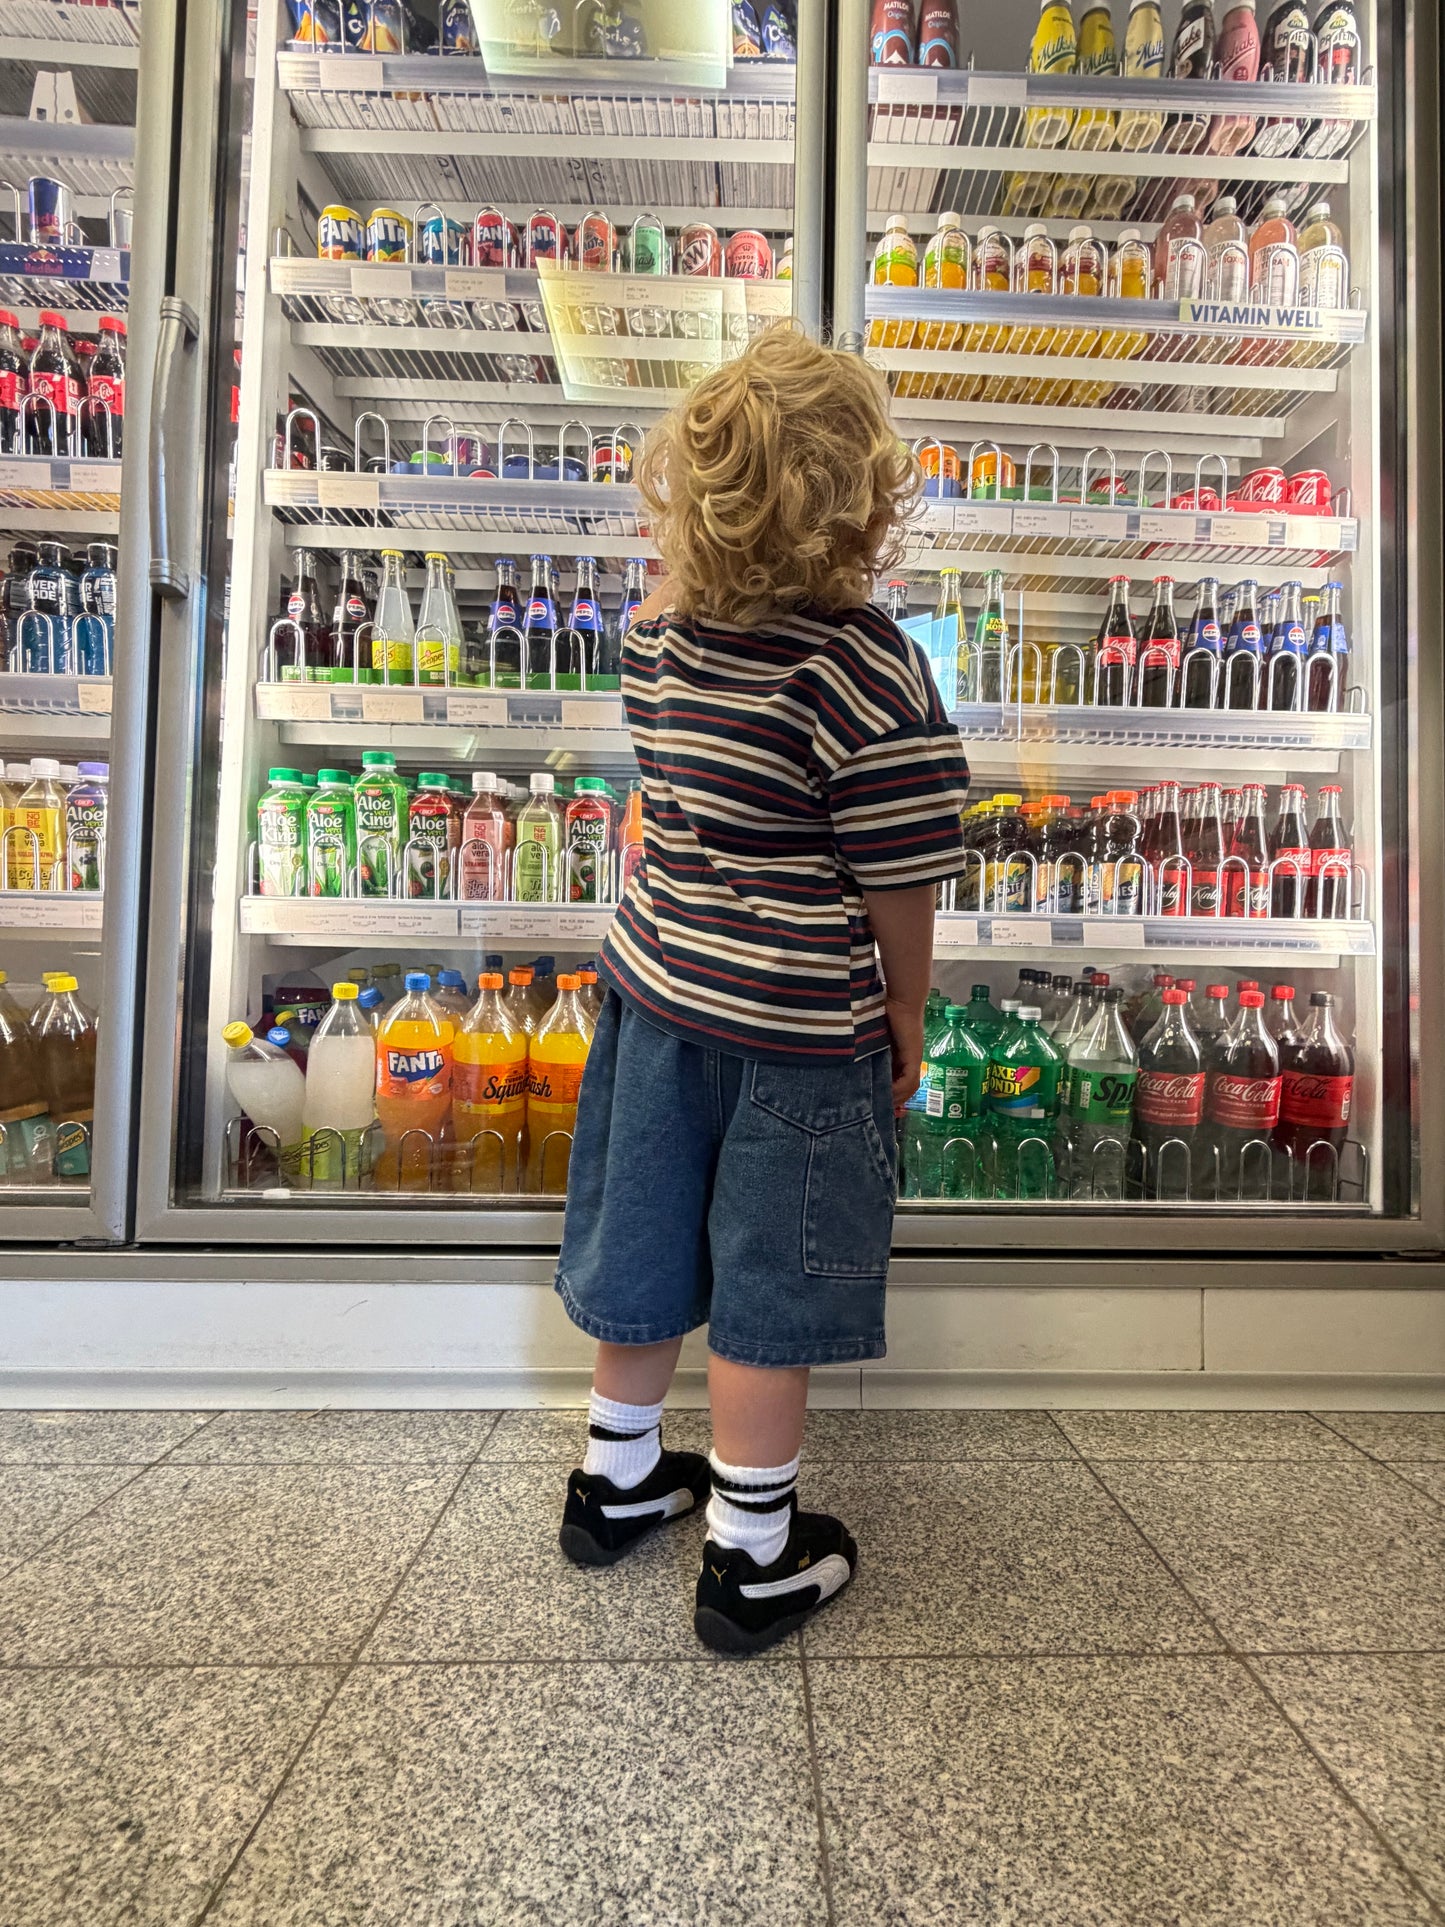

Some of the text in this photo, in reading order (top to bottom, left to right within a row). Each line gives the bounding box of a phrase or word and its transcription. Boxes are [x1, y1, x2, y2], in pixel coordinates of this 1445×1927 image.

[1190, 304, 1323, 329] VITAMIN WELL
[358, 796, 392, 811] Aloe
[67, 806, 103, 821] Aloe
[261, 812, 297, 826] Aloe
[309, 813, 343, 827] Aloe
[359, 811, 393, 828] King
[411, 815, 445, 830] Aloe
[571, 820, 604, 834] Aloe
[263, 827, 297, 845] King
[388, 1050, 444, 1074] FANTA
[1137, 1072, 1200, 1098] Coca-Cola
[1213, 1076, 1278, 1102] Coca-Cola
